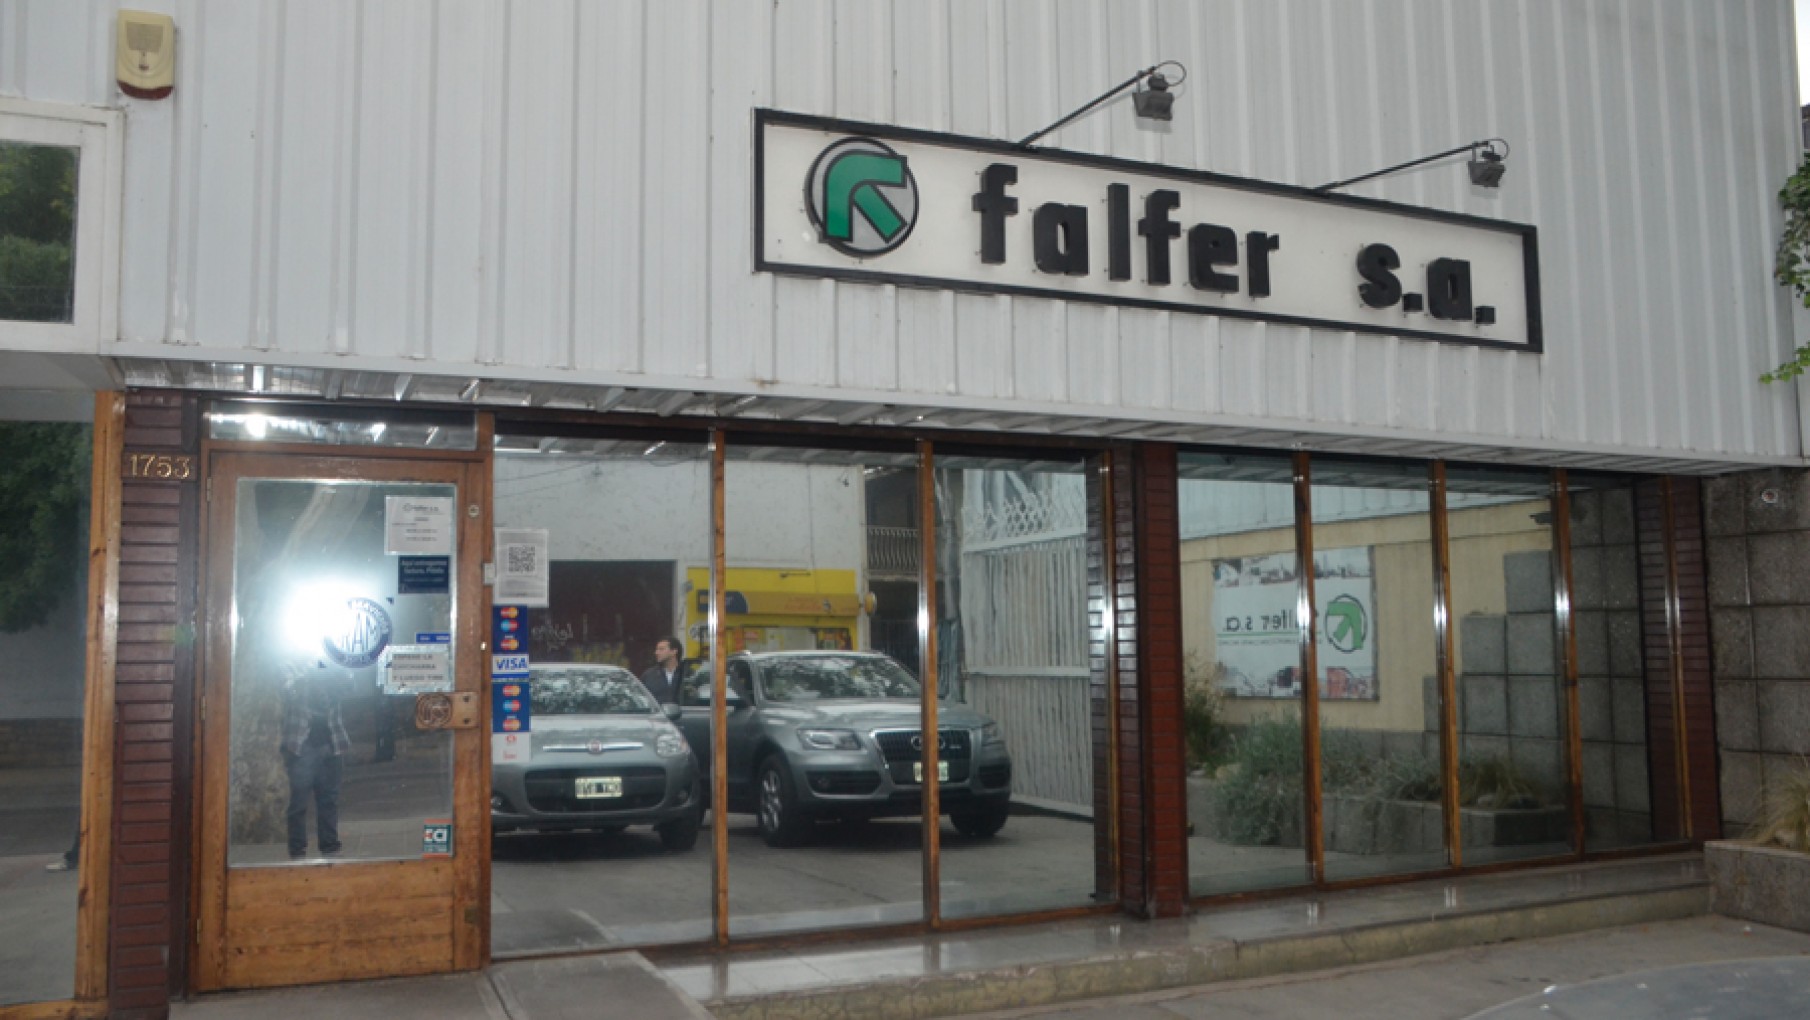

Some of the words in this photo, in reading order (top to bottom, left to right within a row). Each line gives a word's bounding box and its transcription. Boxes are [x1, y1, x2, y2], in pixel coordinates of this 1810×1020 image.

[971, 163, 1279, 298] falfer
[1357, 242, 1495, 324] s.a.
[130, 454, 191, 480] 1753
[496, 657, 528, 670] VISA
